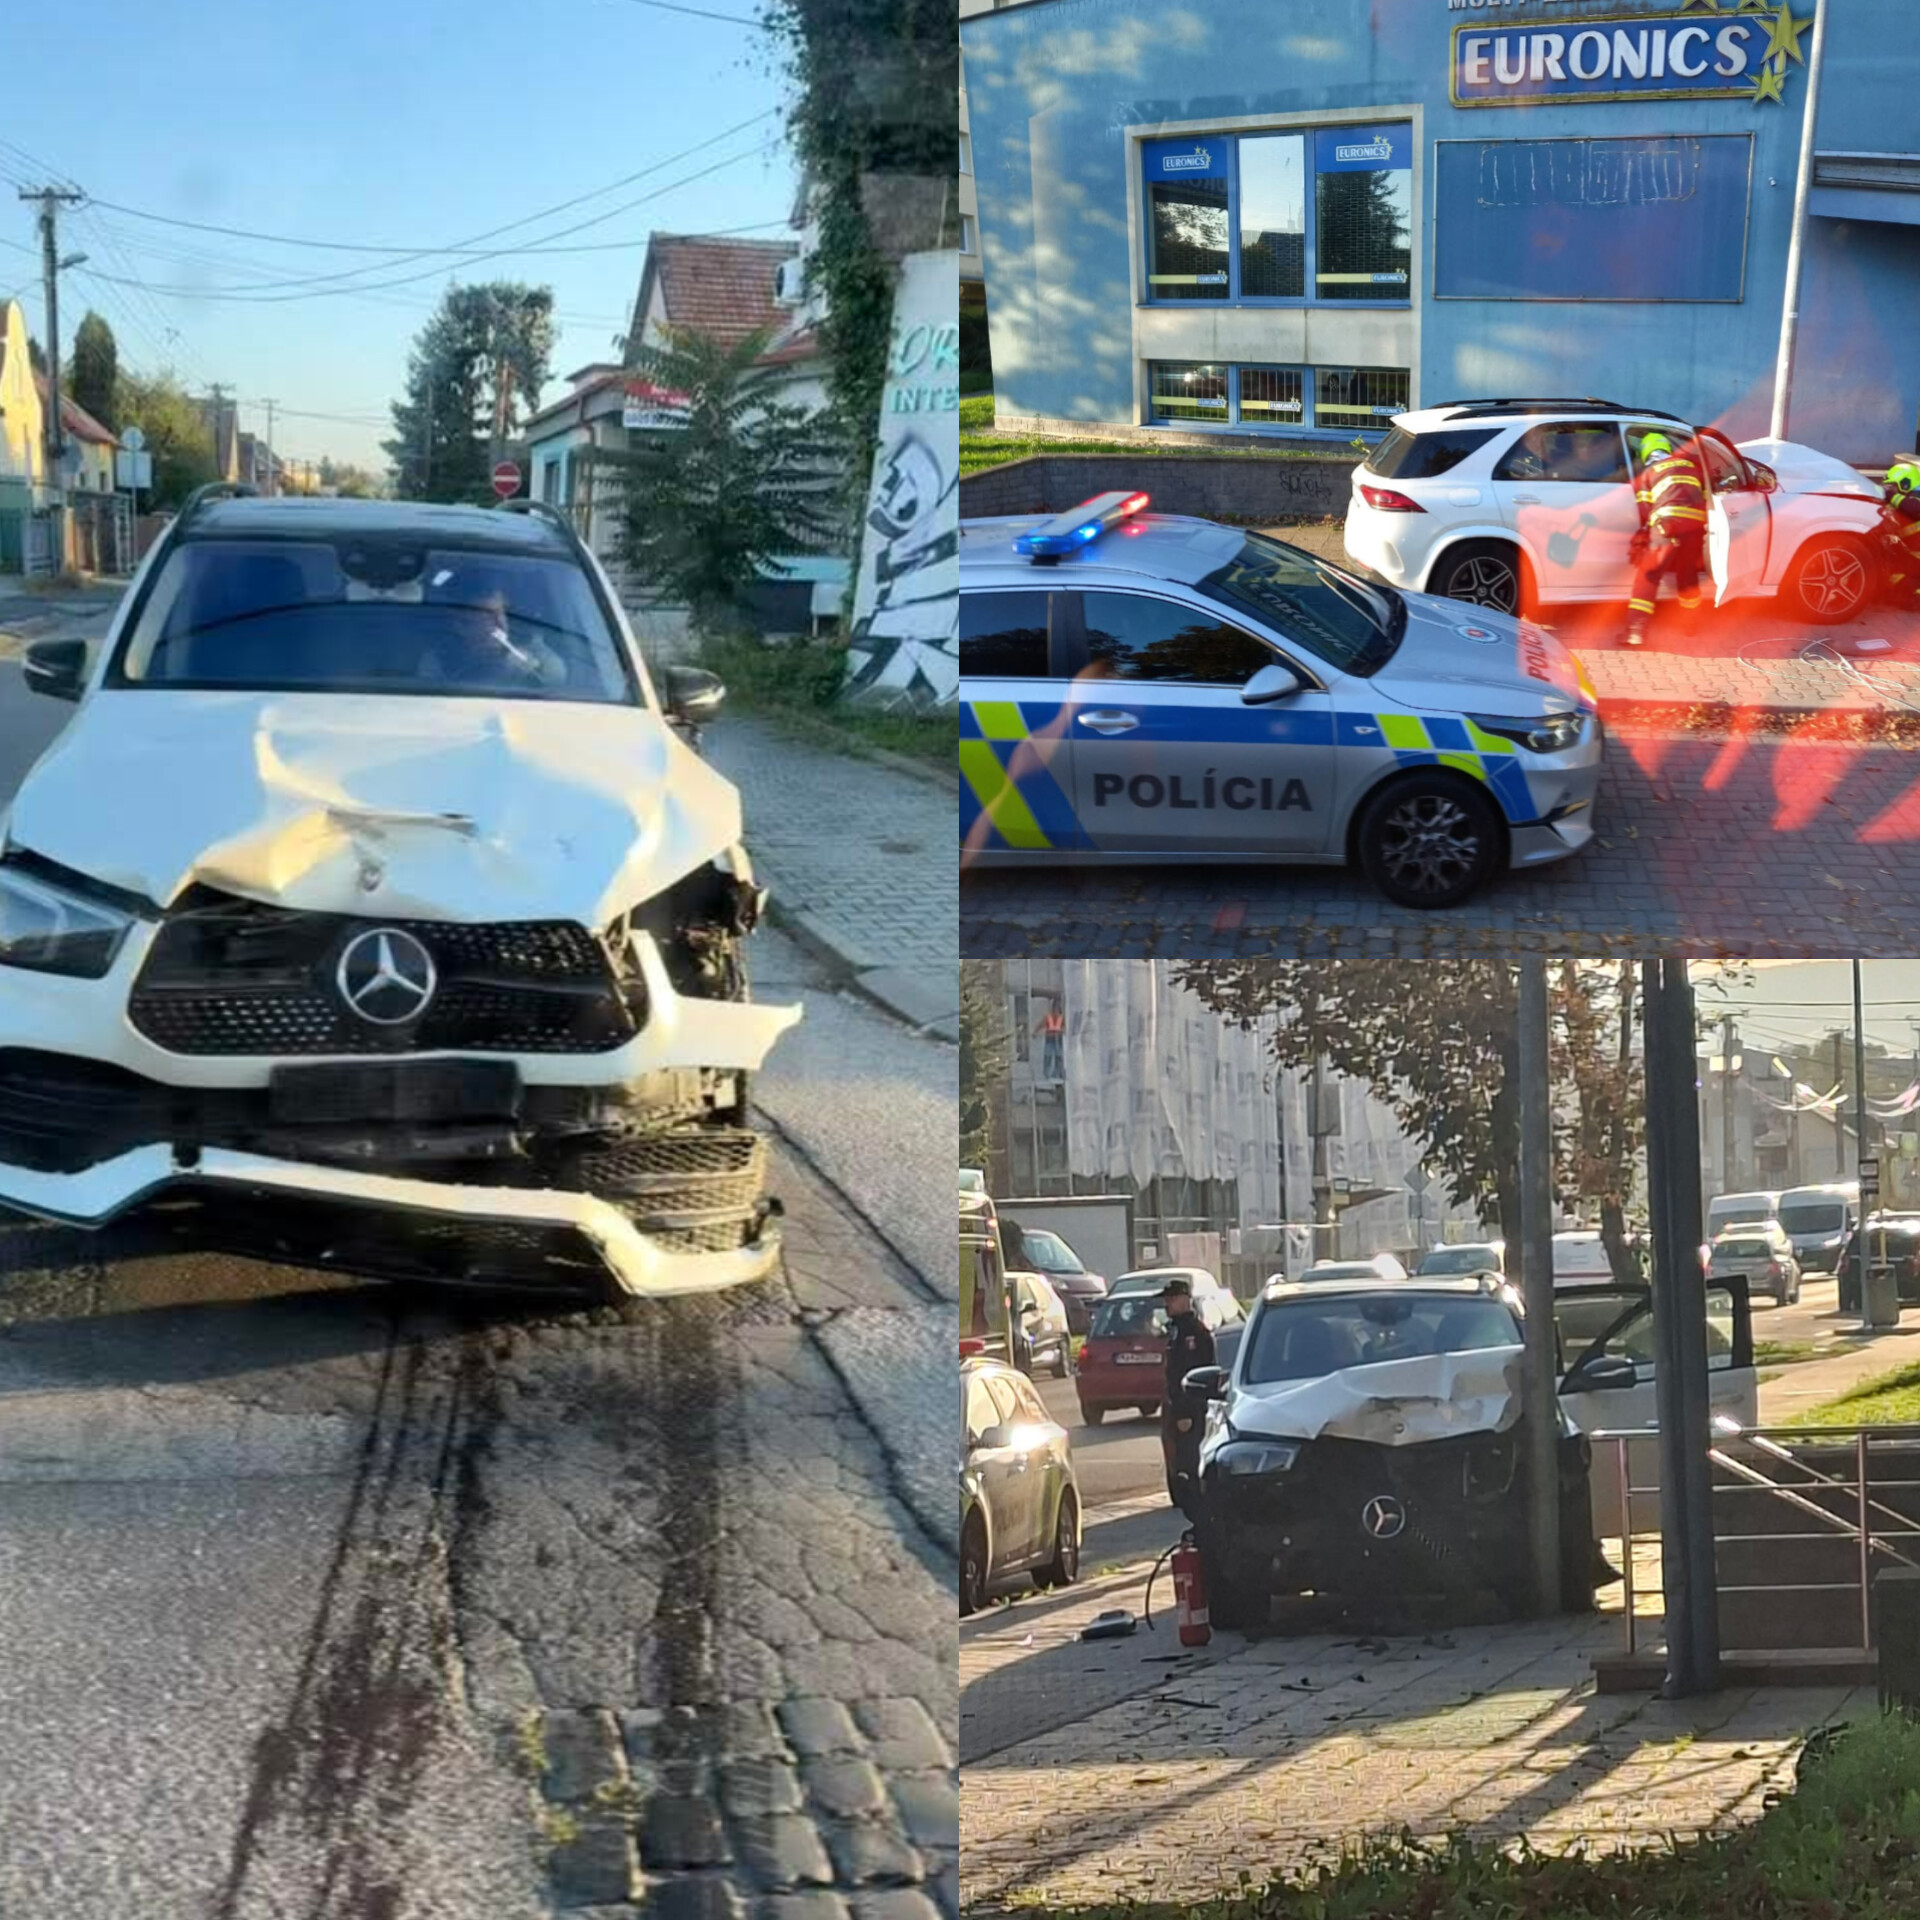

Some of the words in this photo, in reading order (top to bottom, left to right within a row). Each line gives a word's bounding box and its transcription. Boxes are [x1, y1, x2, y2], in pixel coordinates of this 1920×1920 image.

[1464, 25, 1750, 85] EURONICS
[1166, 156, 1206, 168] EURONICS
[1339, 147, 1386, 158] EURONICS
[1094, 768, 1314, 811] POLÍCIA
